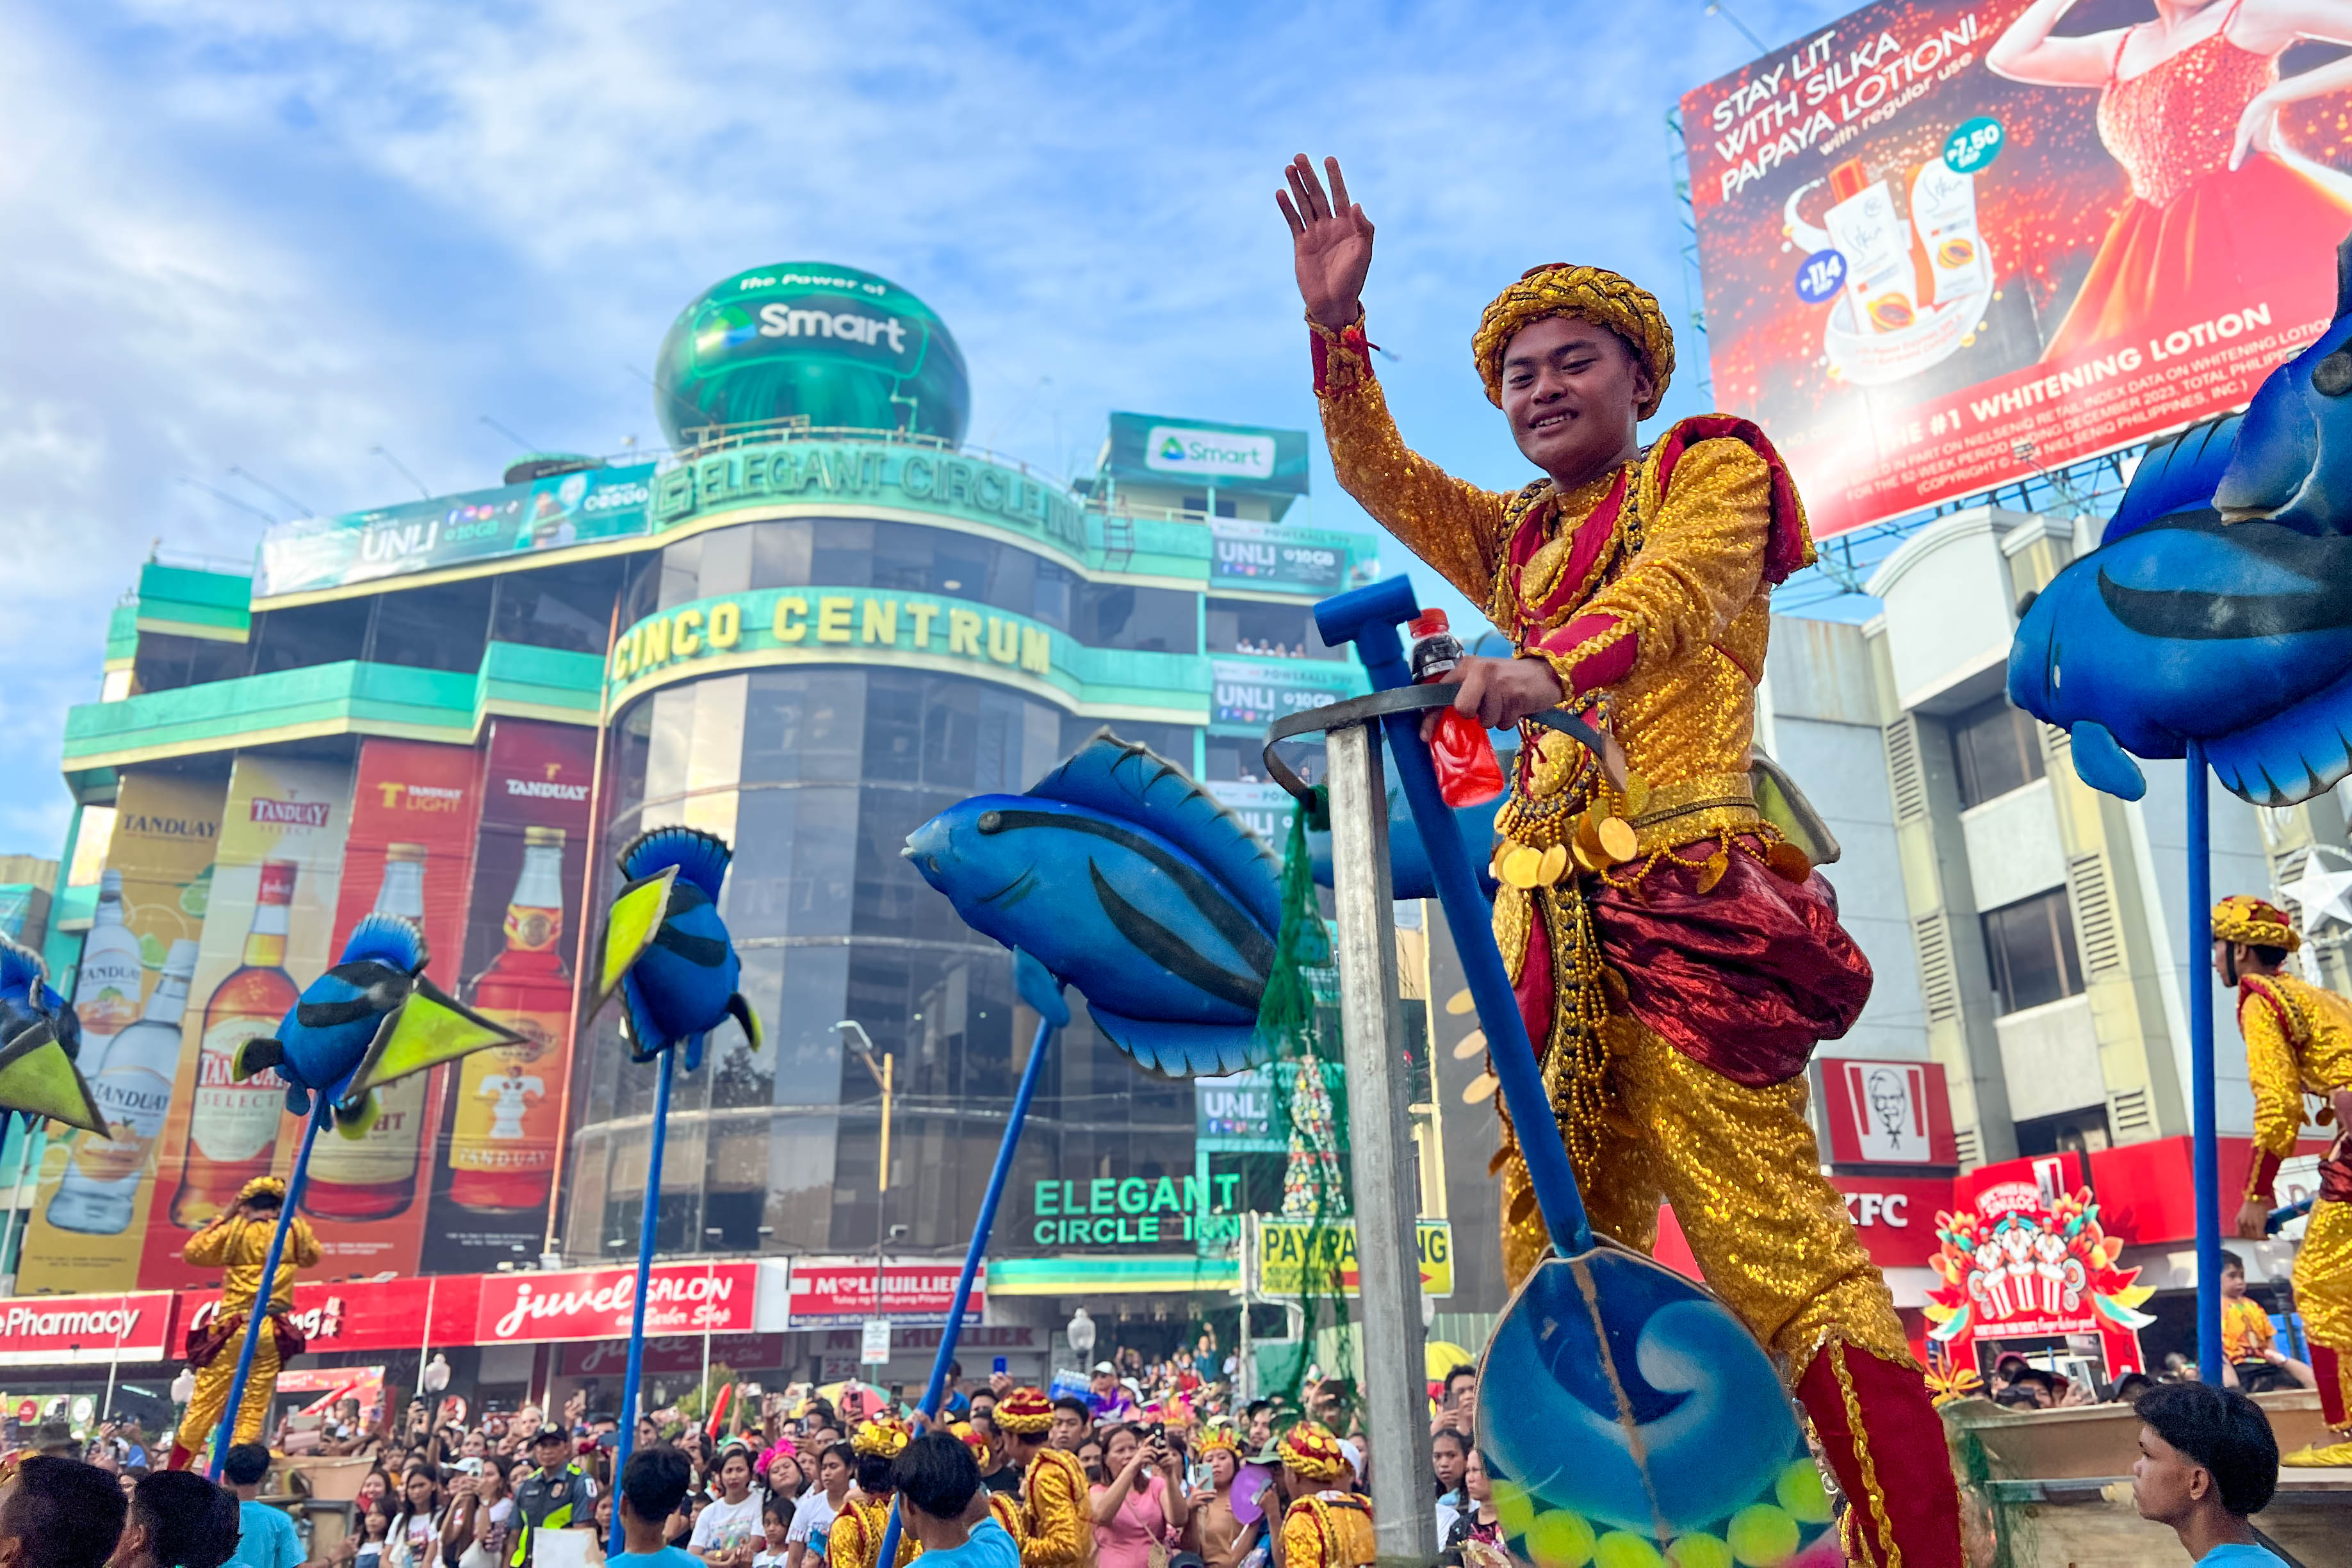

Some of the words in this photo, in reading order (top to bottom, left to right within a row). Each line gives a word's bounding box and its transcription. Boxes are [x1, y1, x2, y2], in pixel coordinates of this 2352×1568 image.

[1713, 63, 1785, 132] STAY
[1792, 29, 1836, 81] LIT
[1715, 90, 1799, 162] WITH
[1806, 32, 1901, 106] SILKA
[1721, 109, 1836, 202] PAPAYA
[1840, 13, 1979, 122] LOTION!
[1819, 124, 1859, 156] with
[1862, 77, 1933, 129] regular
[1937, 51, 1973, 80] use
[740, 276, 777, 291] The
[781, 273, 858, 289] Power
[862, 282, 886, 297] of
[759, 302, 907, 355] Smart
[1929, 407, 1961, 437] #1
[1969, 347, 2143, 423] WHITENING
[2149, 302, 2273, 363] LOTION
[1941, 440, 1963, 455] ON
[2036, 400, 2087, 426] RETAIL
[2088, 388, 2127, 408] INDEX
[2129, 373, 2164, 393] DATA
[2166, 365, 2189, 381] ON
[2191, 336, 2276, 374] WHITENING
[1957, 440, 2008, 471] PERIOD
[2064, 397, 2140, 432] DECEMBER
[2181, 370, 2229, 392] TOTAL
[1189, 441, 1262, 466] Smart
[699, 450, 888, 505] ELEGANT
[900, 455, 1041, 525] CIRCLE
[1045, 492, 1088, 550] INN
[361, 520, 439, 561] UNLI
[1218, 541, 1275, 566] UNLI
[612, 602, 742, 683] CINCO
[772, 595, 1051, 676] CENTRUM
[1216, 684, 1275, 711] UNLI
[405, 796, 462, 813] LIGHT
[505, 779, 590, 801] TANDUAY
[123, 813, 220, 838] TANDUAY
[253, 799, 329, 826] TANDUAY
[202, 1092, 277, 1108] SELECT
[458, 1147, 549, 1168] TANDUAY
[1034, 1173, 1241, 1216] ELEGANT
[1033, 1216, 1160, 1245] CIRCLE
[1183, 1214, 1241, 1241] INN
[1266, 1228, 1314, 1262] PAY
[644, 1277, 733, 1303] SALON
[690, 1304, 731, 1327] Shop
